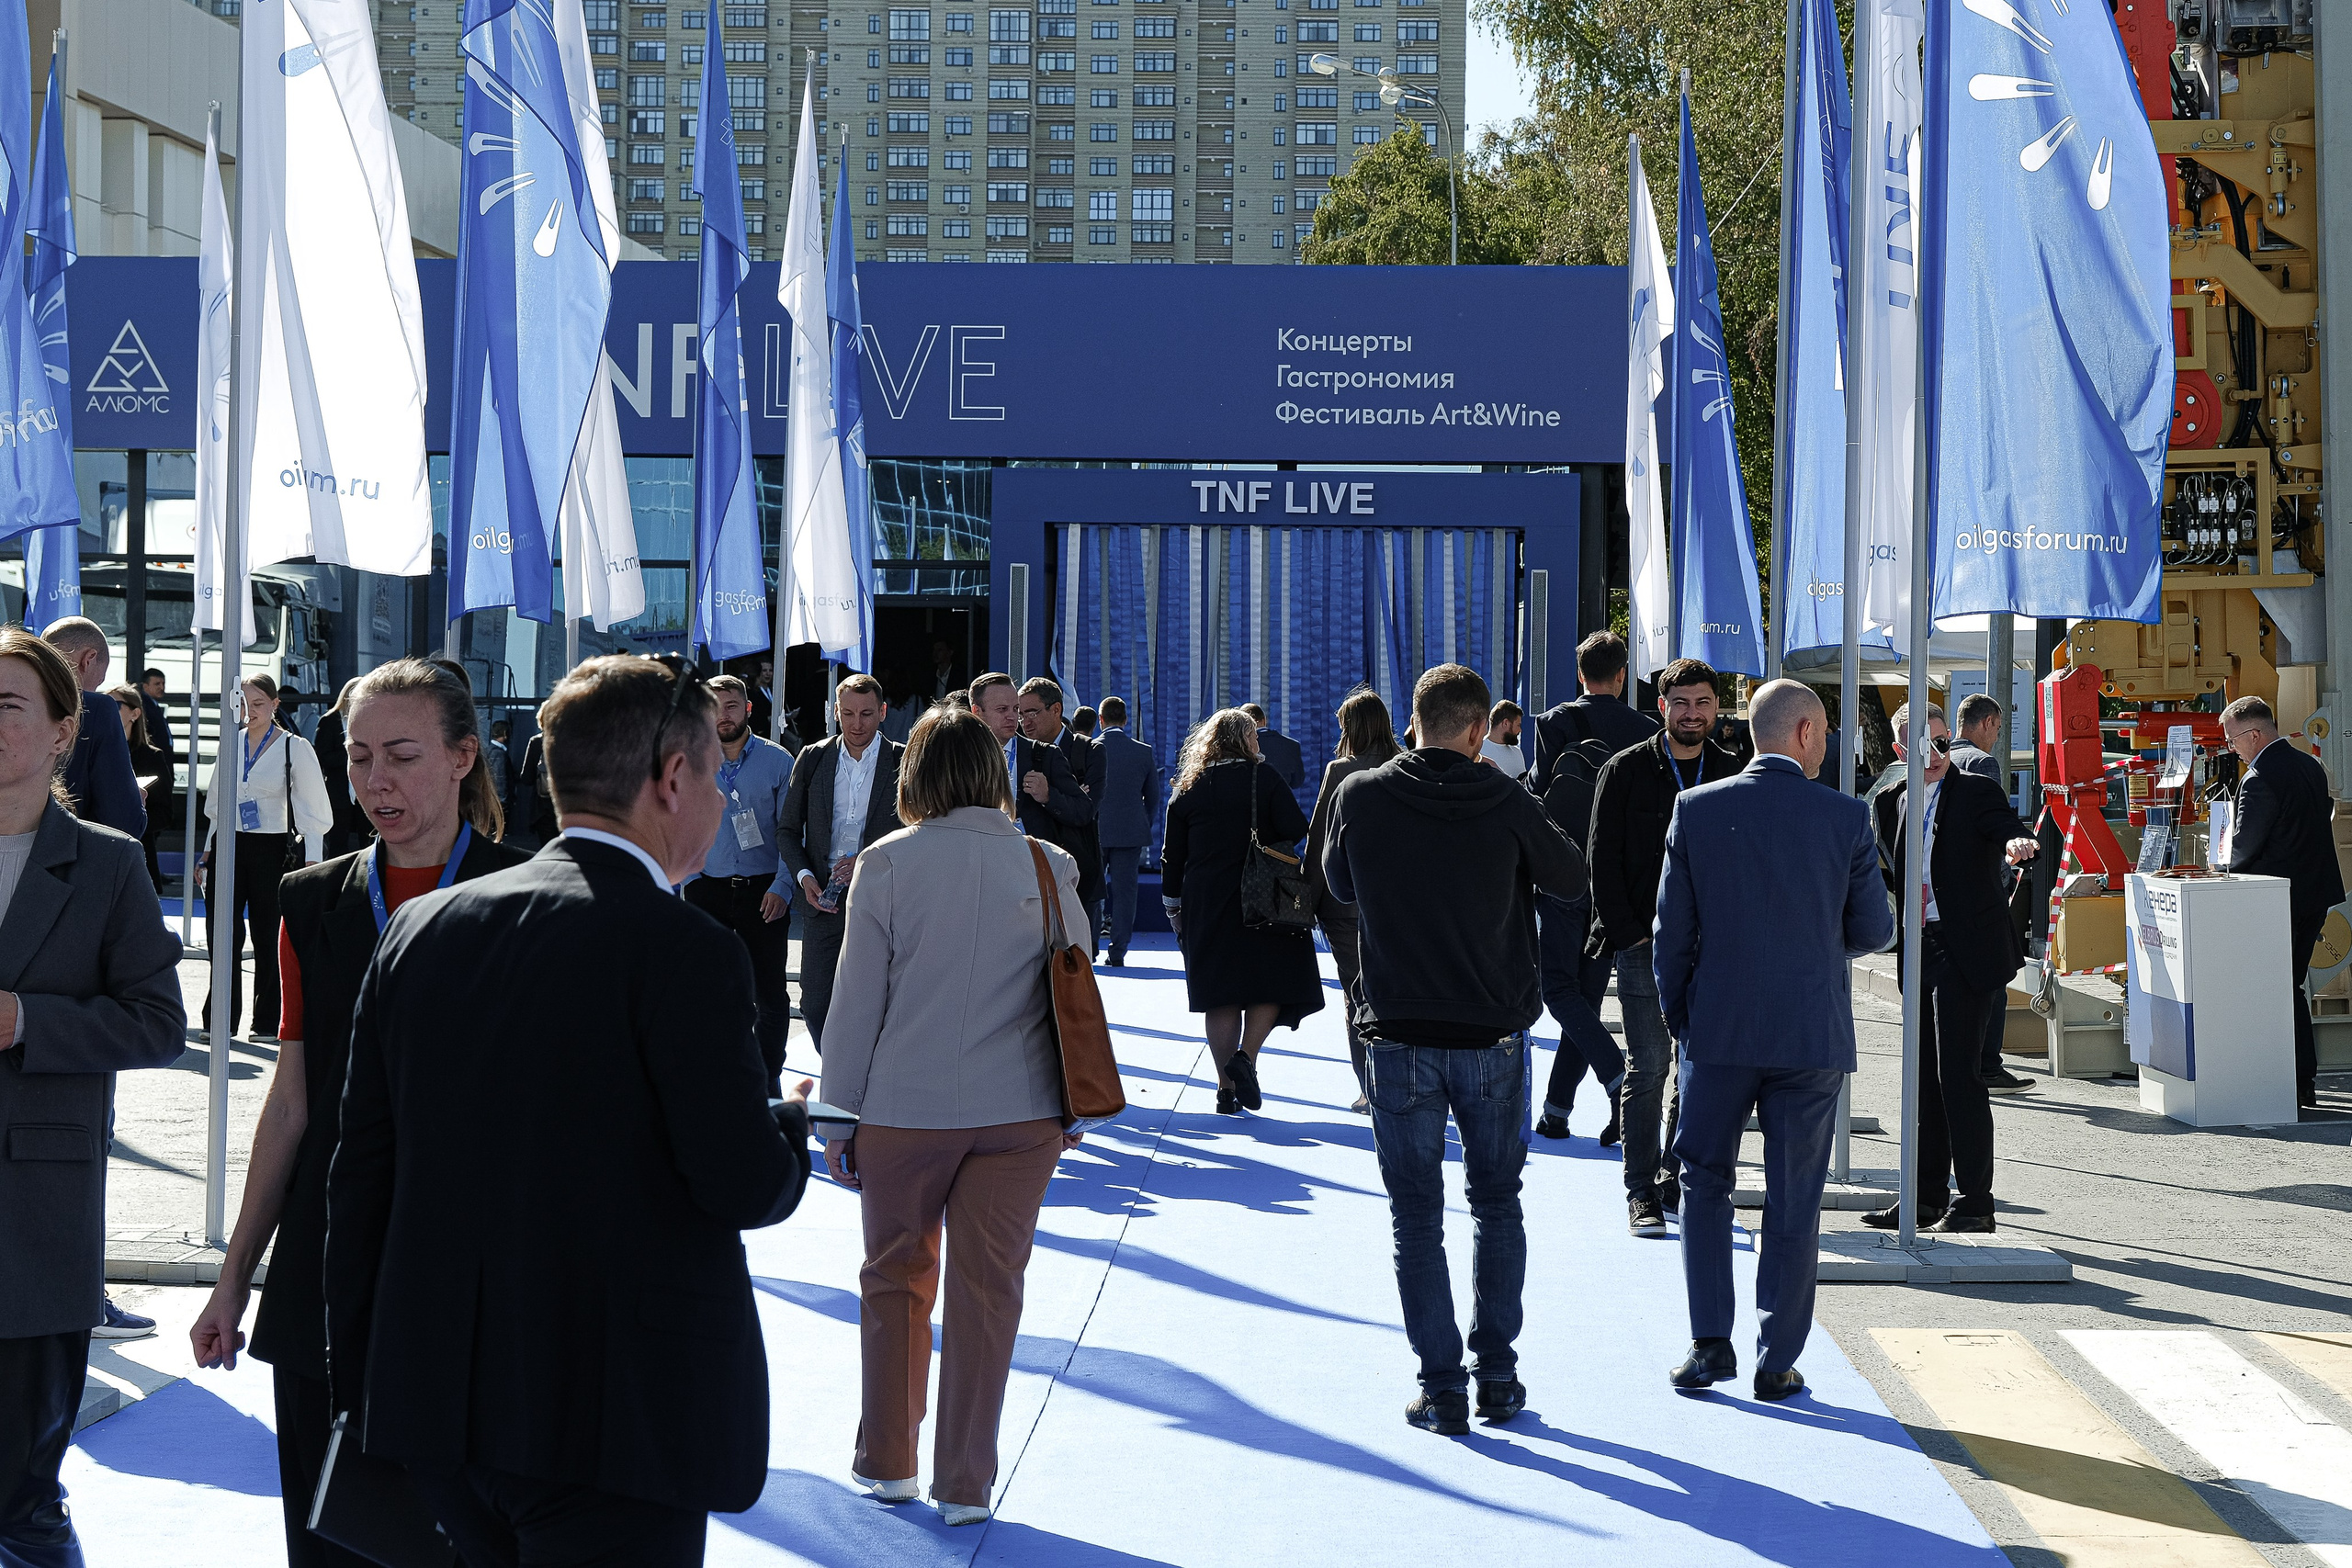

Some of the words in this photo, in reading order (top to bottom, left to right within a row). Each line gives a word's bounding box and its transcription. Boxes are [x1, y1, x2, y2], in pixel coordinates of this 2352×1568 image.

[1276, 327, 1413, 359] Концерты
[606, 322, 698, 418] NF
[763, 323, 1005, 421] LVE
[1276, 364, 1455, 395] Гастрономия
[85, 394, 170, 414] АЛЮМС
[1274, 400, 1425, 426] Фестиваль
[1430, 402, 1561, 427] Art&Wine
[279, 458, 380, 501] oim.ru
[1191, 479, 1272, 513] TNF
[1284, 481, 1375, 515] LIVE
[1955, 524, 2129, 557] oilgasforum.ru
